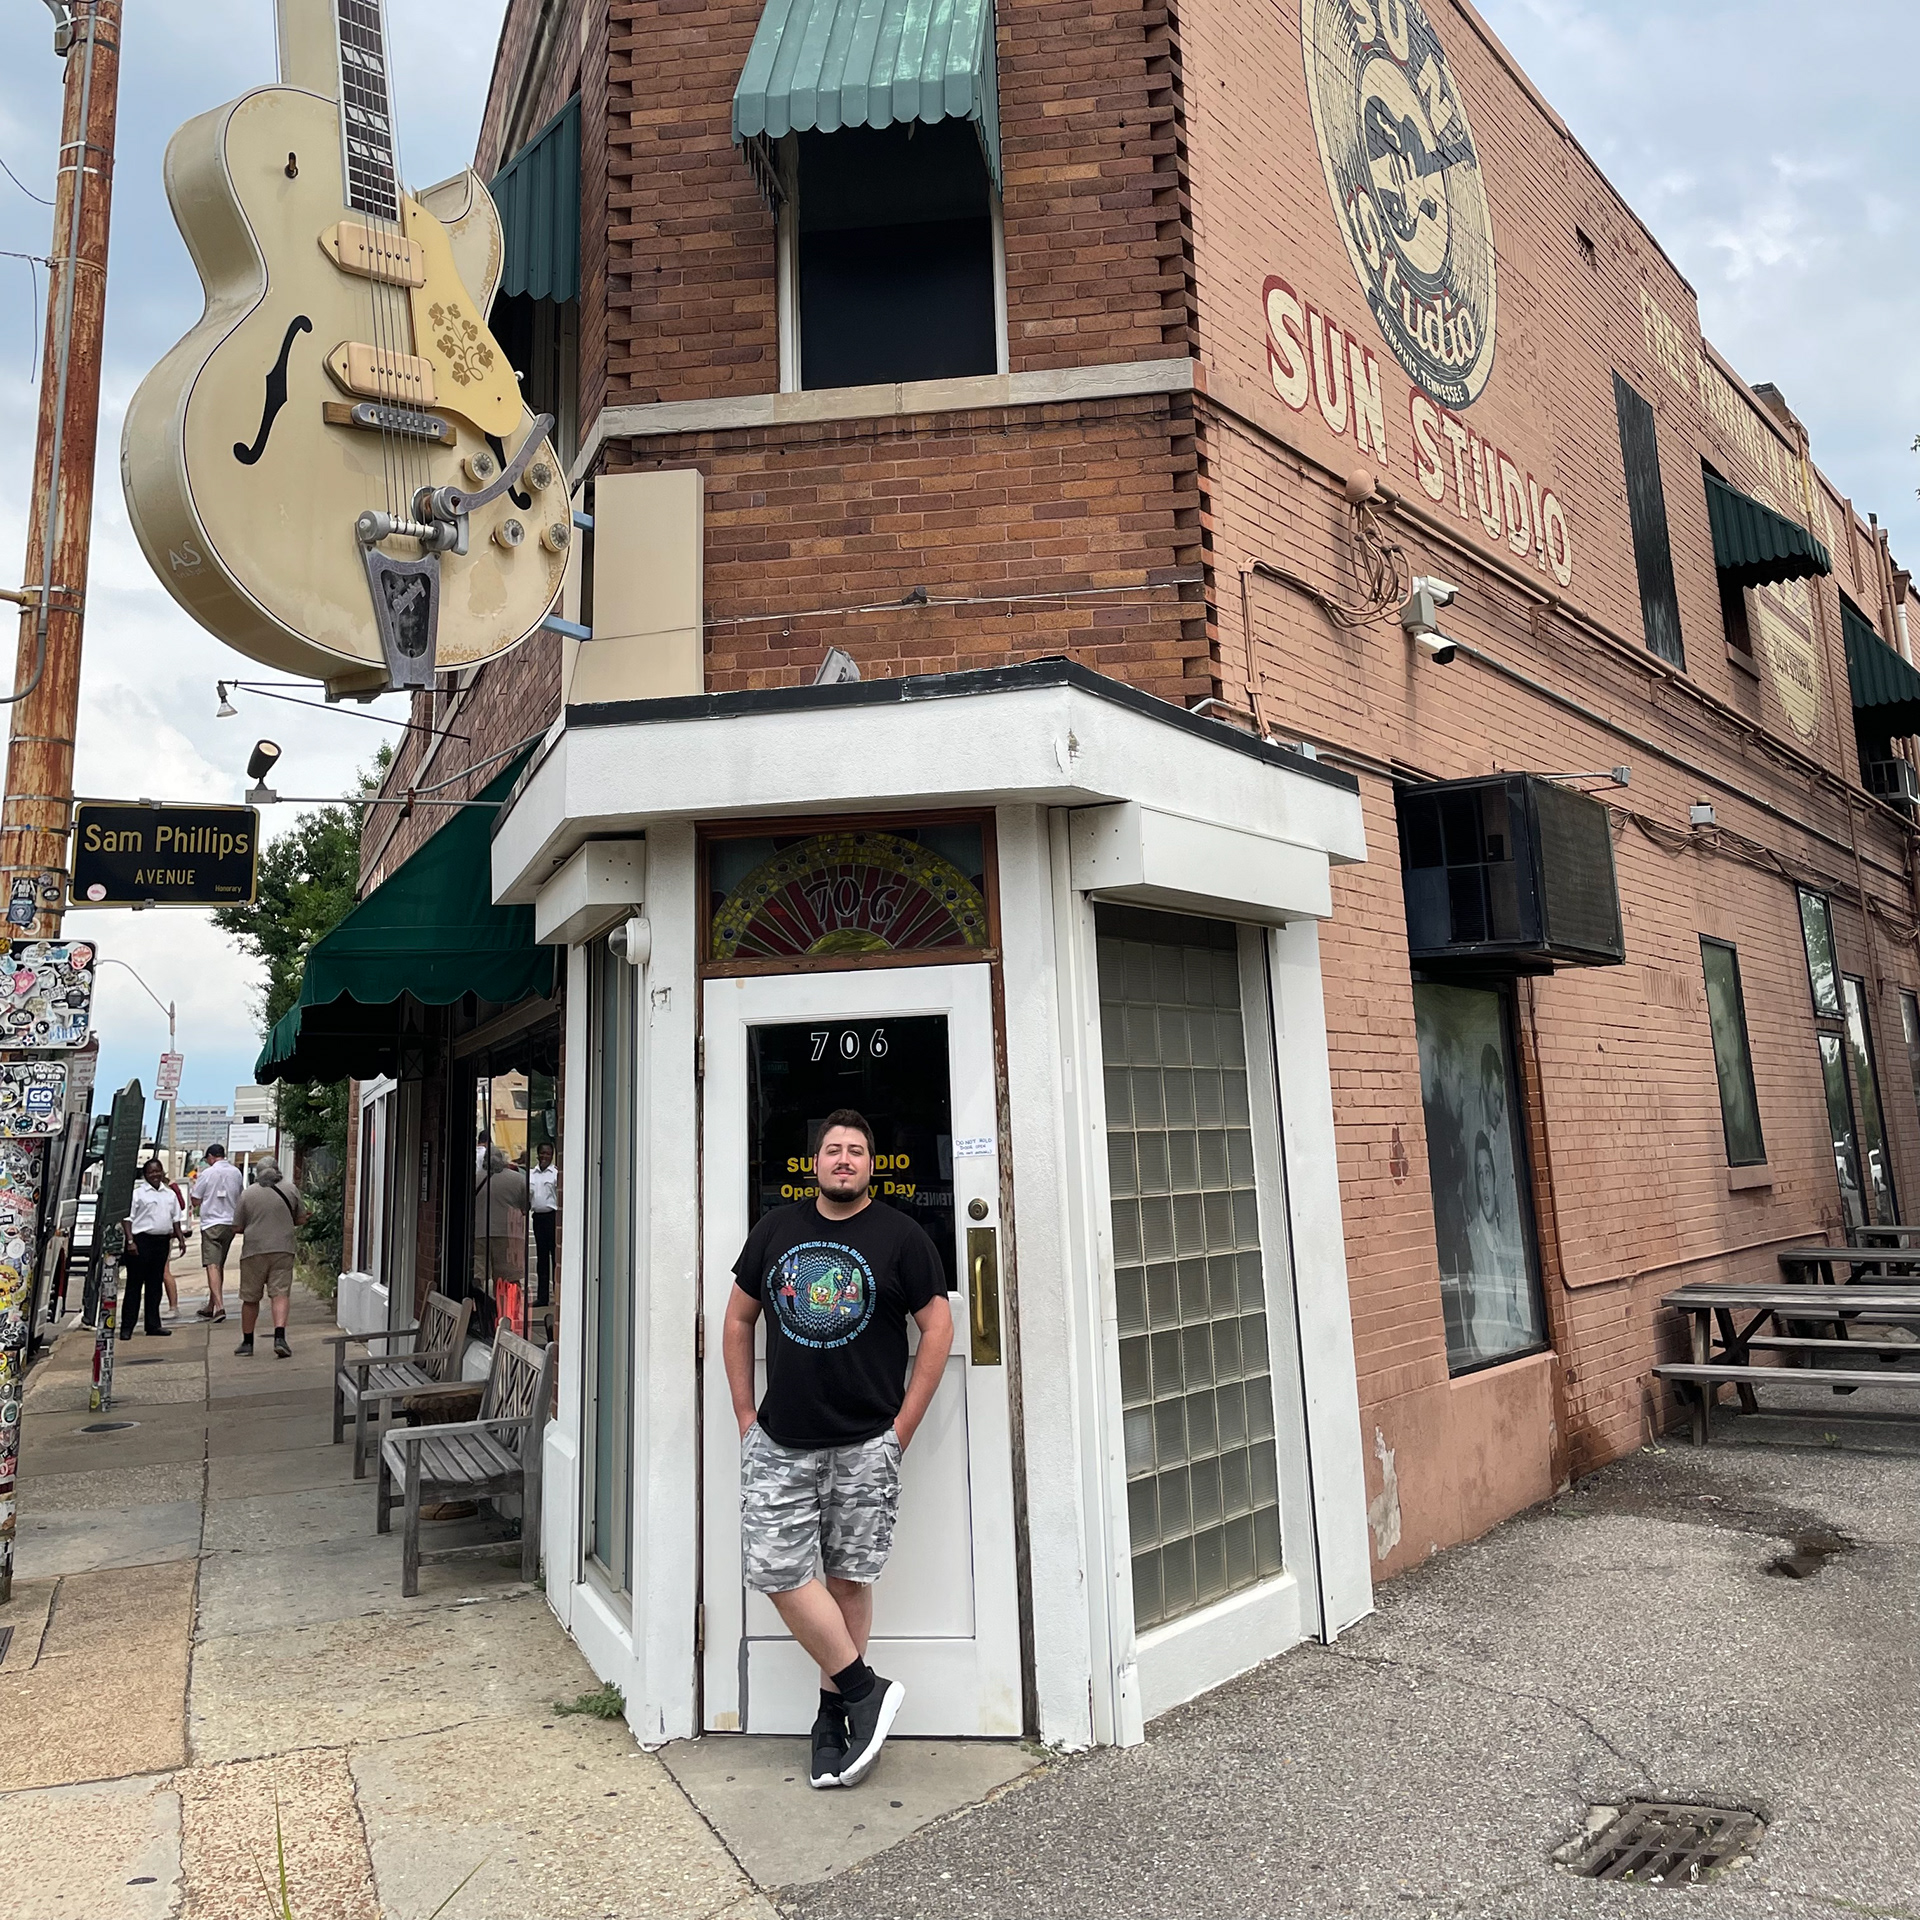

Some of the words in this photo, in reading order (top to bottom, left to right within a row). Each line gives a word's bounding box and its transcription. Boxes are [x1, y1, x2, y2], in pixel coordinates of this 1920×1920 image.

[1347, 186, 1476, 367] Studio
[1420, 371, 1465, 402] TENNESSEE
[1638, 285, 1691, 394] FREE
[1694, 347, 1764, 474] PARKING
[1262, 275, 1389, 468] SUN
[1408, 385, 1573, 588] STUDIO
[84, 824, 143, 853] Sam
[155, 825, 249, 861] Phillips
[134, 869, 196, 885] AVENUE
[214, 884, 242, 894] Honorary
[803, 876, 898, 924] 706
[30, 1090, 52, 1102] GO
[787, 1157, 813, 1173] SU
[875, 1154, 910, 1170] DIO
[883, 1181, 916, 1198] Day
